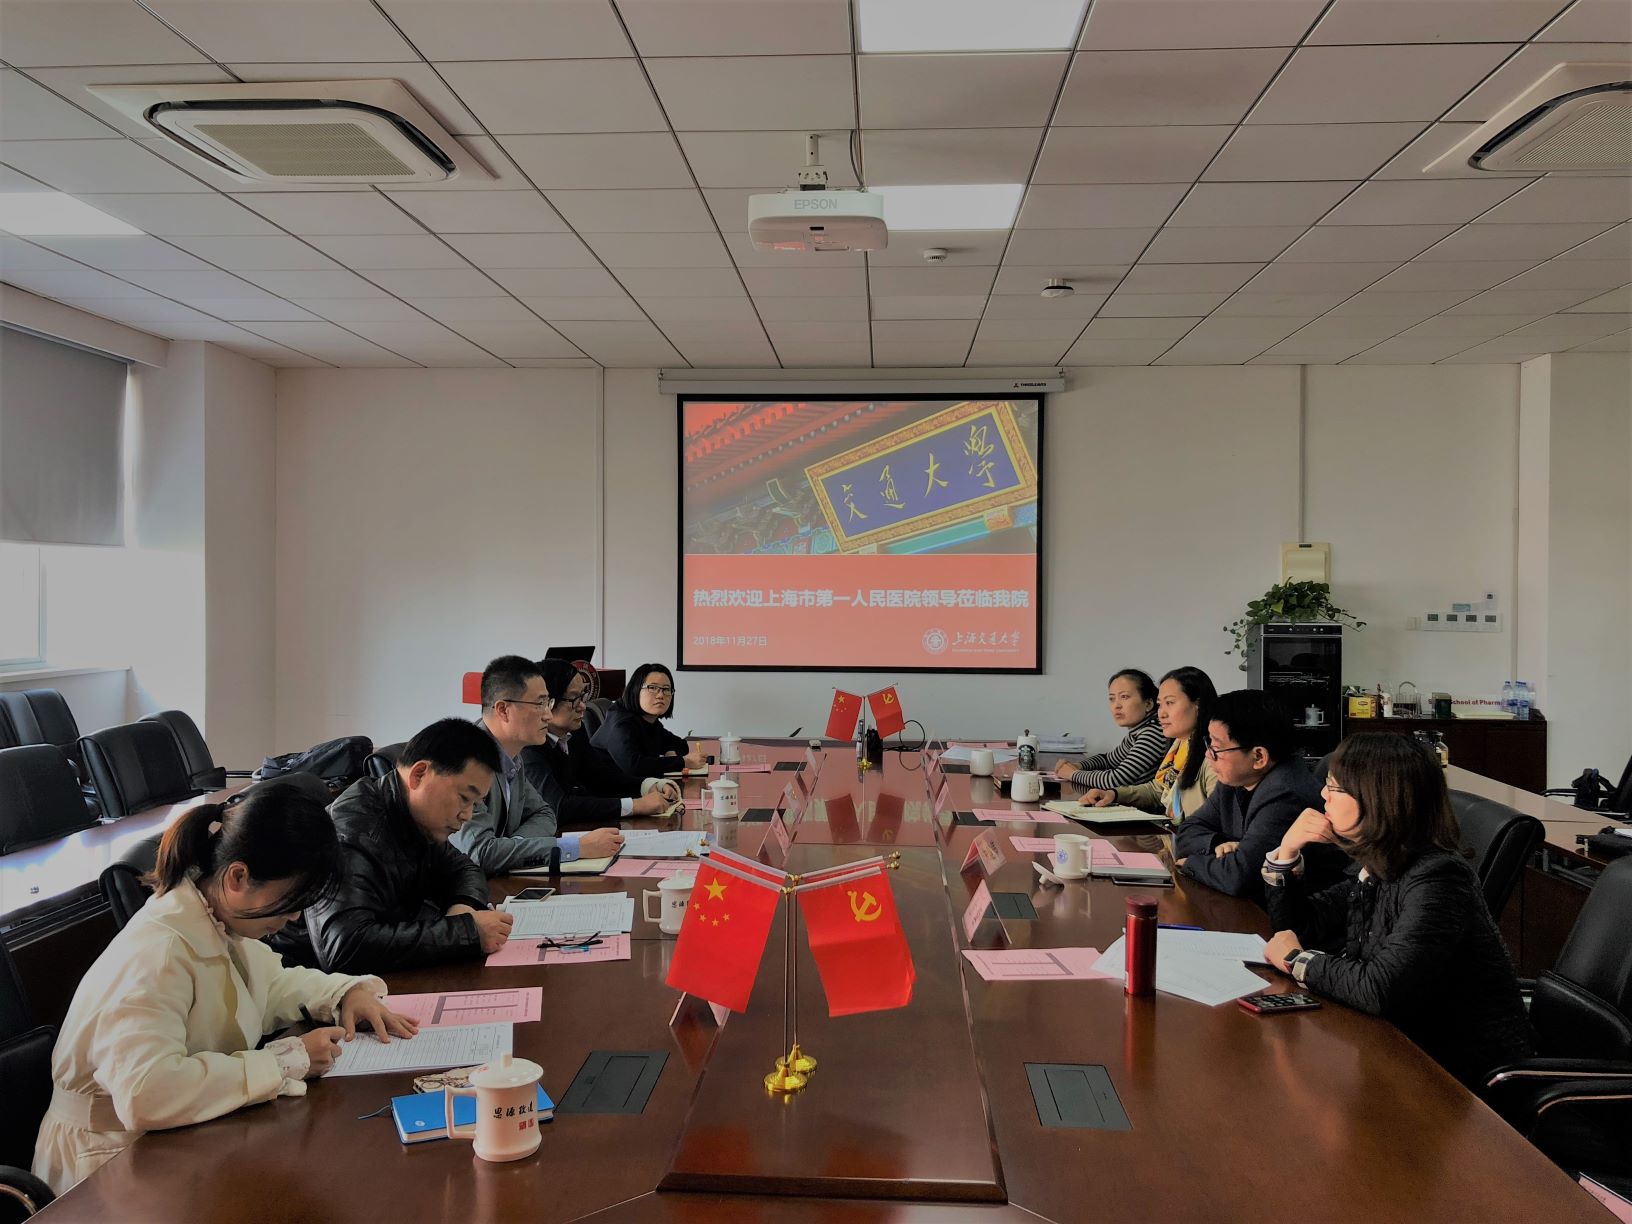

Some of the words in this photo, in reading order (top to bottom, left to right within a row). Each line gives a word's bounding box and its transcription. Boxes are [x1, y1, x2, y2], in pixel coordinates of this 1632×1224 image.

[794, 199, 838, 210] EPSON
[692, 589, 1029, 608] 热烈欢迎上海市第一人民医院领导莅临我院
[693, 636, 769, 647] 2018年11月27日
